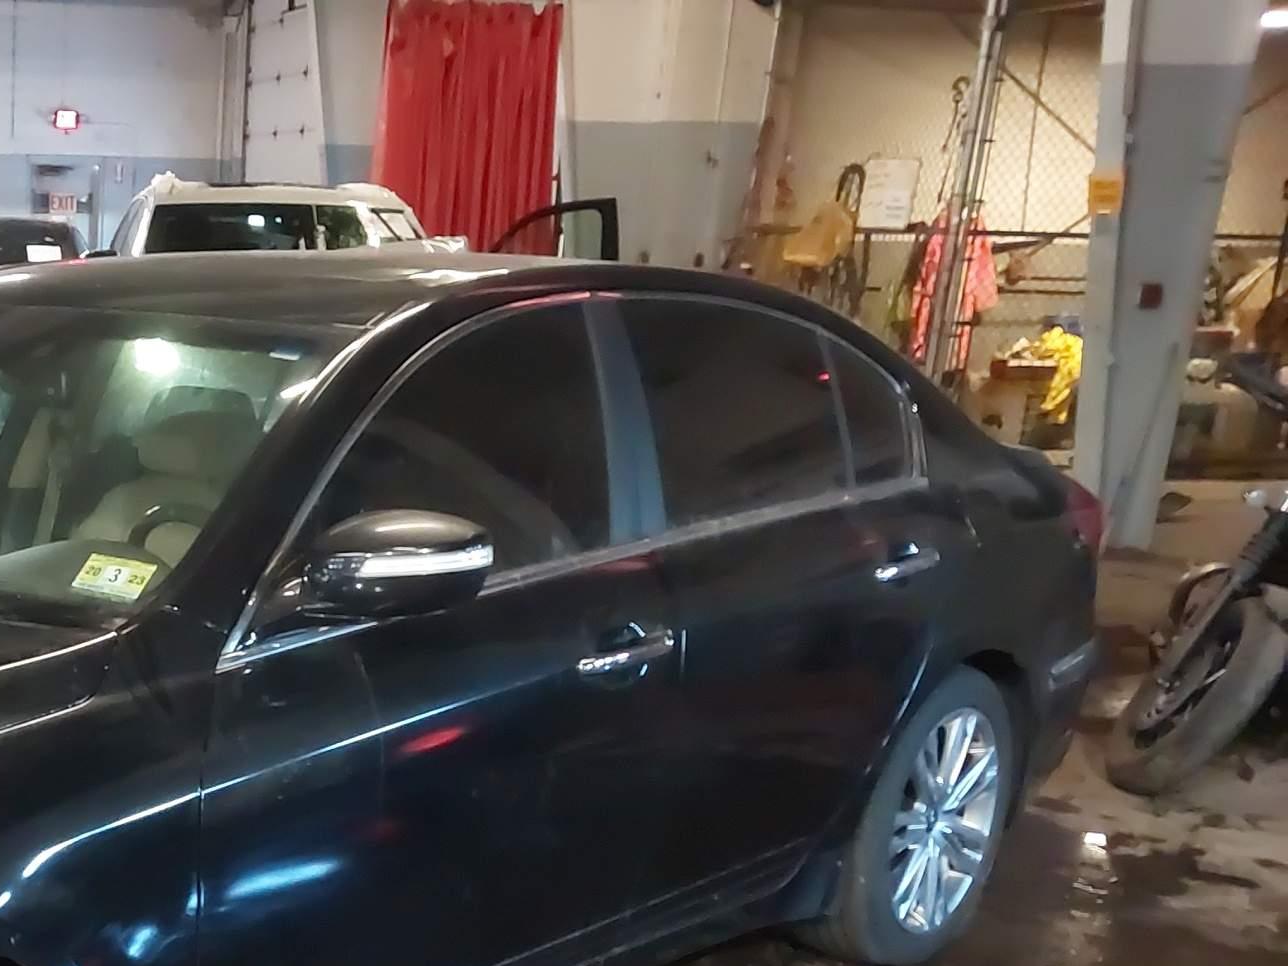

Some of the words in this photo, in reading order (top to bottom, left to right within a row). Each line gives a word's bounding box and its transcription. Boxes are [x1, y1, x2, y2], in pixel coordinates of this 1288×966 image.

[51, 195, 75, 211] EXIT
[85, 566, 102, 577] 20
[108, 568, 122, 583] 3
